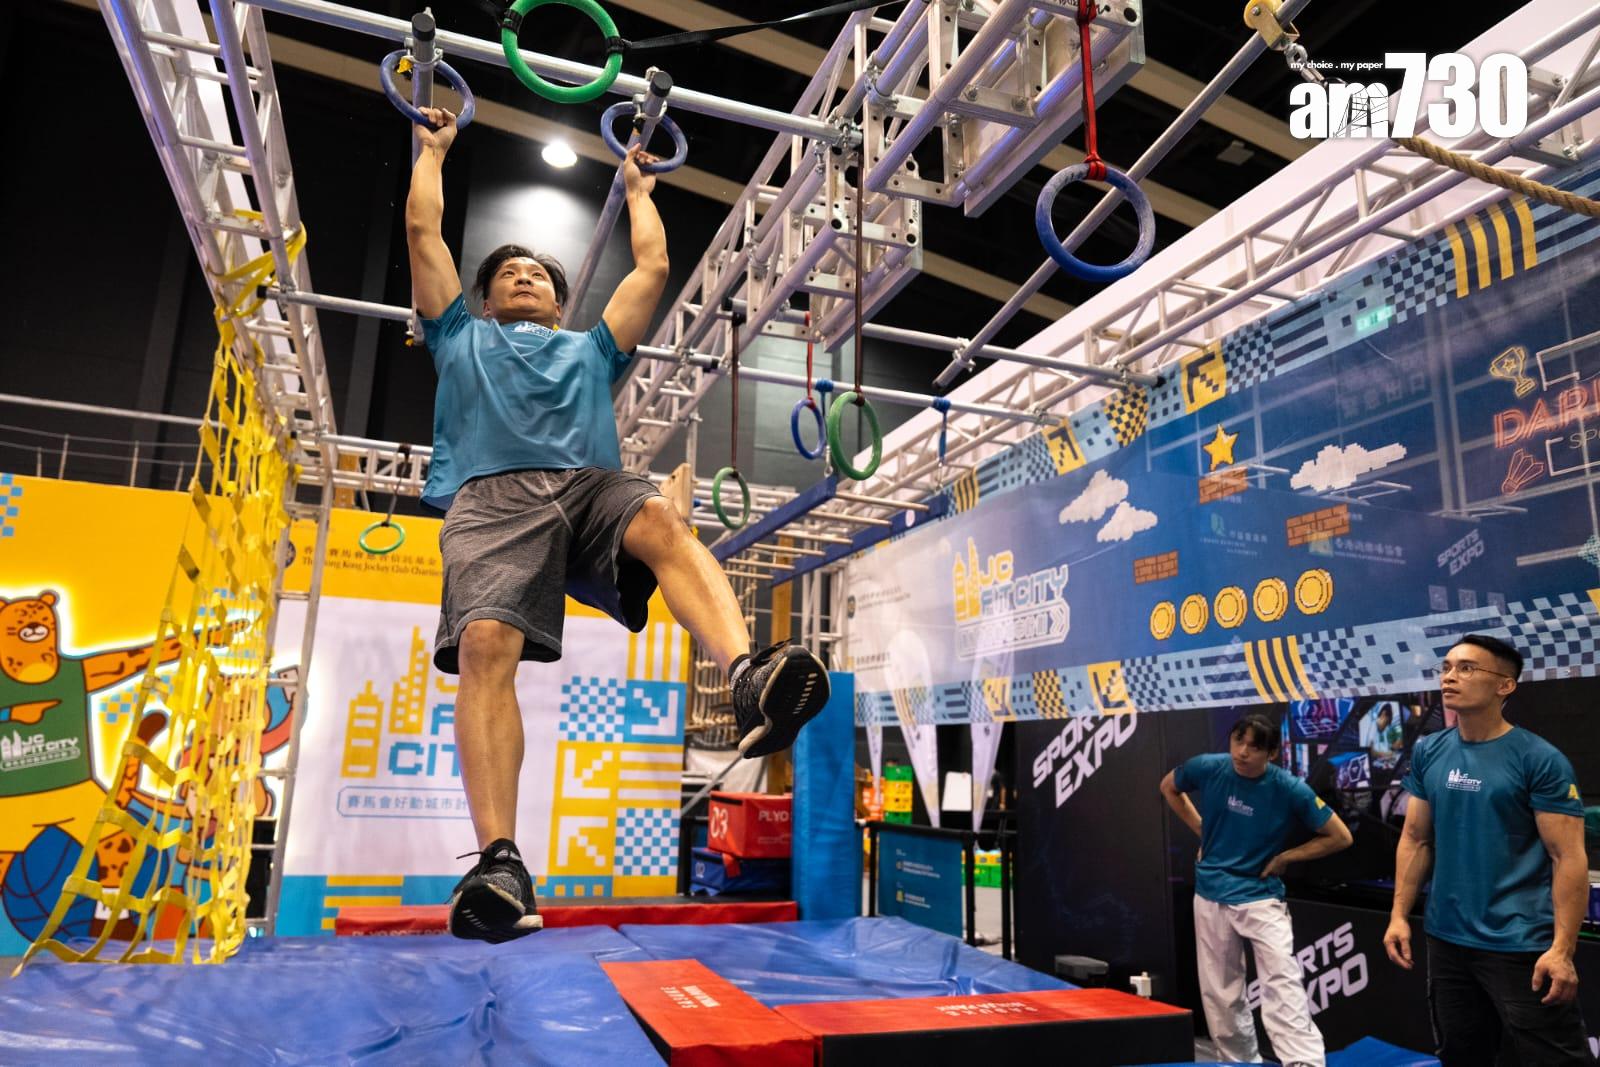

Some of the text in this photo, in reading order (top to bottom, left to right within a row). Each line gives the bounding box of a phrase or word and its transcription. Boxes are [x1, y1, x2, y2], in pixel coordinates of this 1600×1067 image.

[1449, 539, 1484, 576] EXPO
[1055, 711, 1137, 808] EXPO
[758, 810, 789, 822] PLYO
